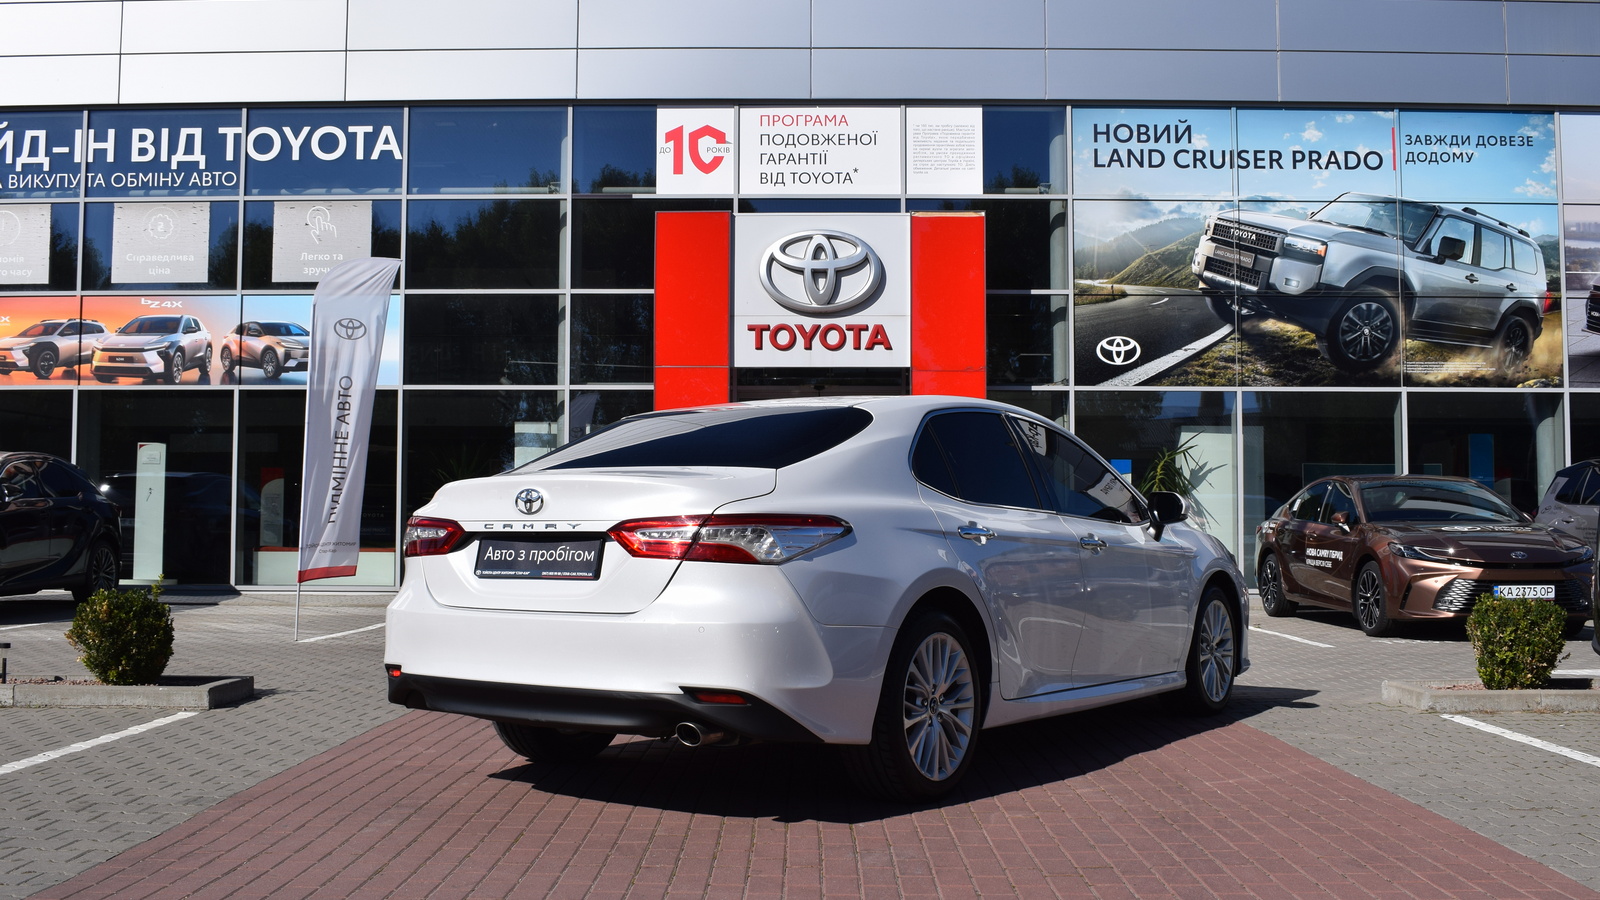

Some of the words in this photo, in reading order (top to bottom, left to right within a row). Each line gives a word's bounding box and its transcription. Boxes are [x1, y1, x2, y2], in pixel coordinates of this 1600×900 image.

[759, 114, 849, 127] ПРОГРАМА
[1093, 119, 1193, 144] НОВИЙ
[131, 127, 207, 170] ВІД
[218, 124, 403, 162] TOYOTA
[759, 130, 879, 149] ПОДОВЖЕНОЇ
[1404, 133, 1471, 149] ЗАВЖДИ
[1475, 134, 1534, 150] ДОВЕЗЕ
[659, 146, 672, 155] ДО
[706, 146, 731, 154] РОКІВ
[759, 150, 828, 165] ГАРАНТІЇ
[1093, 148, 1166, 169] LAND
[1173, 148, 1285, 170] CRUISER
[1292, 149, 1384, 171] PRADO
[1404, 151, 1475, 167] ДОДОМУ
[8, 173, 82, 189] ВИКУПУ
[87, 173, 106, 188] ТА
[111, 171, 185, 188] ОБМІНУ
[189, 171, 238, 187] АВТО
[759, 172, 786, 187] ВІД
[1230, 228, 1256, 241] TOYOTA
[126, 253, 195, 264] Справедлива
[299, 252, 330, 261] Легко
[148, 266, 171, 276] ціна
[747, 323, 893, 351] TOYOTA
[336, 375, 353, 426] АВТО
[484, 522, 583, 531] CAMRY
[484, 546, 516, 561] Авто
[517, 549, 525, 561] з
[529, 546, 595, 567] пробігом
[1515, 586, 1538, 597] 2375
